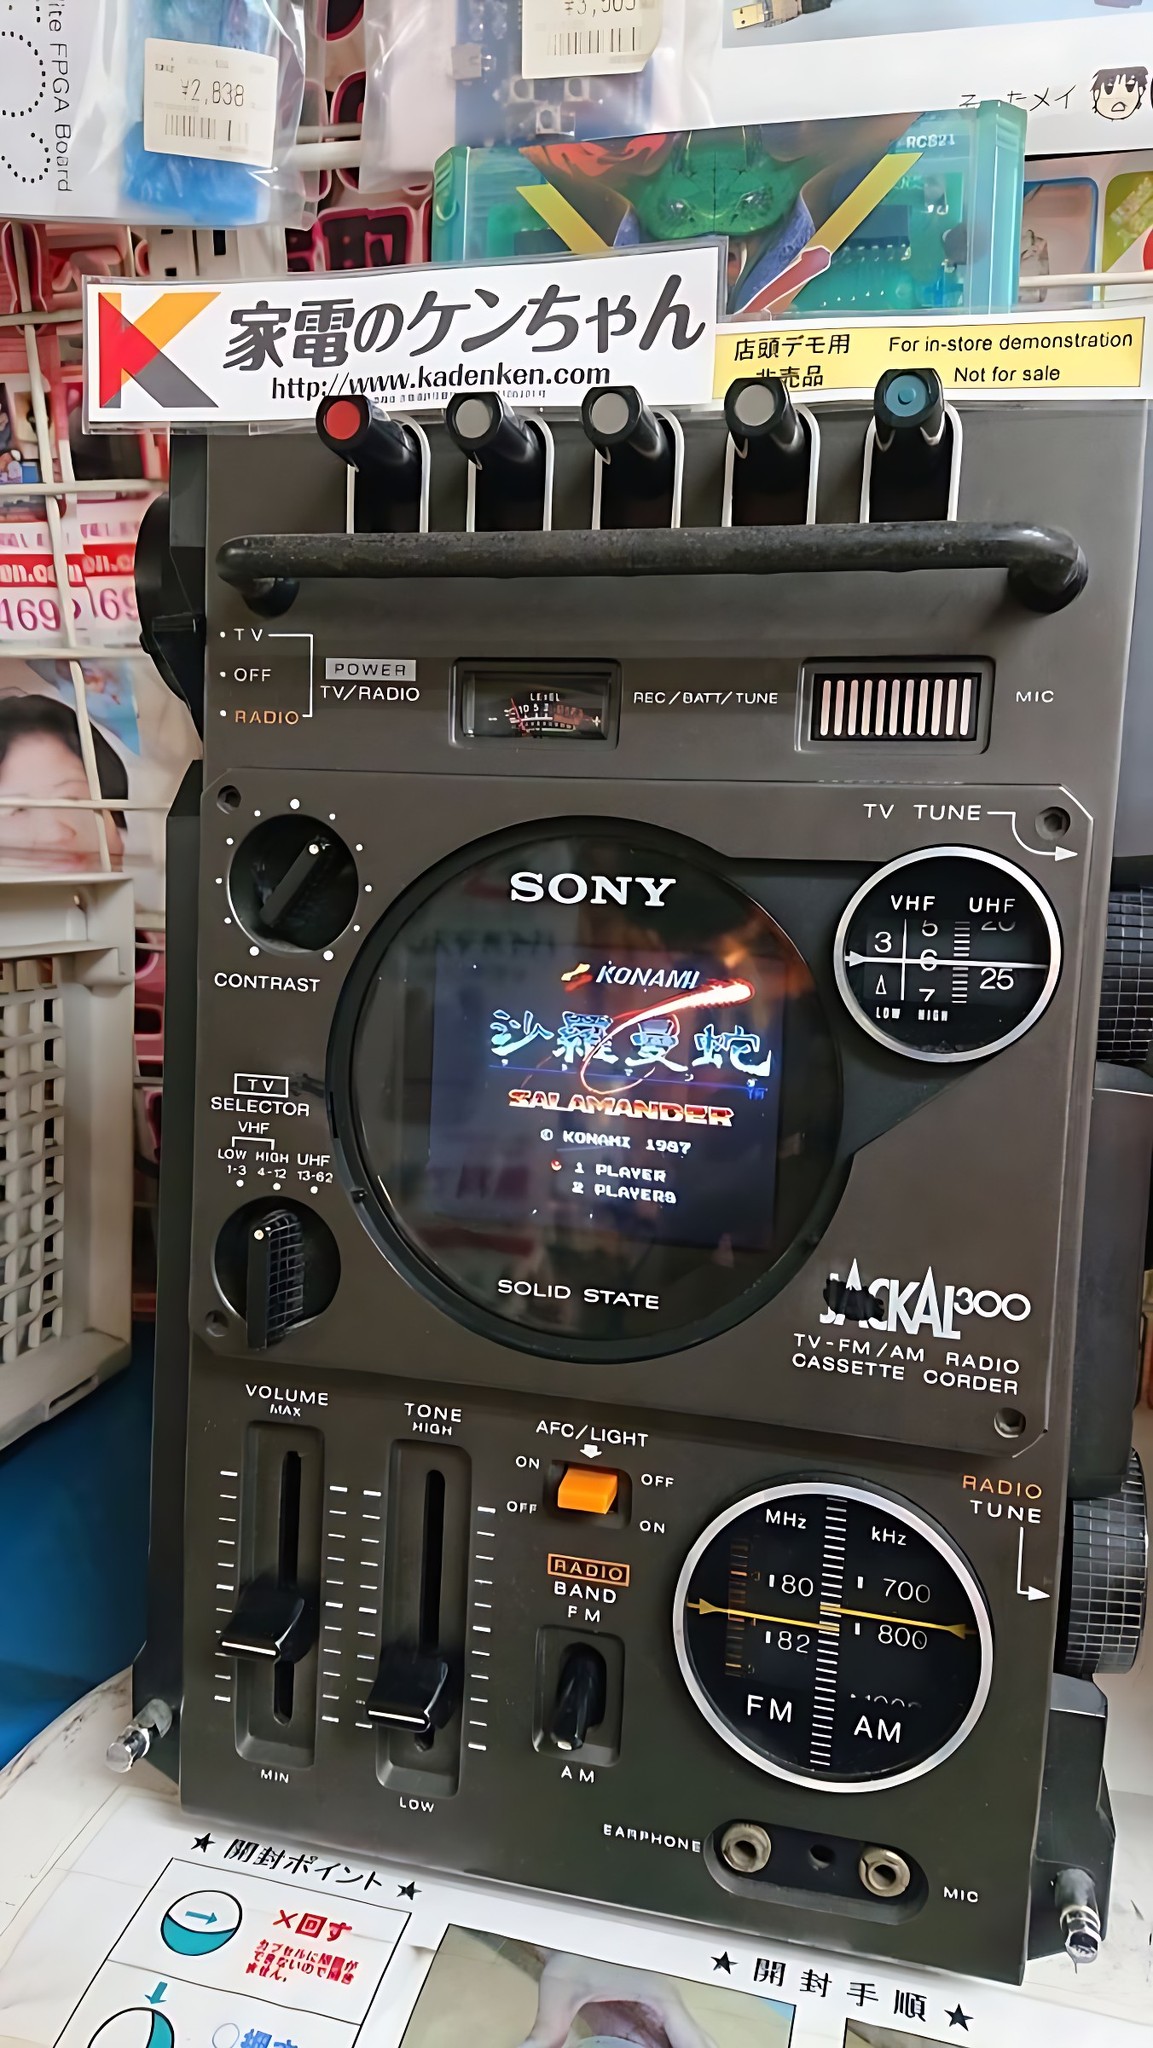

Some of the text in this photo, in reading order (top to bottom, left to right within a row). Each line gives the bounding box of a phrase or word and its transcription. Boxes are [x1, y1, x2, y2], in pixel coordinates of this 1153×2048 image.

[50, 43, 70, 113] FPGA
[181, 78, 245, 107] ¥2,838
[55, 124, 73, 192] Board
[223, 274, 706, 371] 家電のケンちゃん
[734, 333, 851, 362] 店頭デモ用
[889, 332, 1133, 352] For in-store demonstration
[271, 363, 612, 401] http://www.kadenken.com
[954, 366, 1061, 382] Not for sale
[233, 628, 264, 642] TV
[233, 667, 272, 682] OFF
[334, 662, 407, 677] POWER
[320, 684, 420, 702] TV/RADIO
[633, 690, 779, 706] REC/BATT/TUNE
[1015, 689, 1055, 704] MIC
[234, 709, 300, 725] RADIO
[863, 803, 982, 822] TV TUNE
[510, 871, 676, 908] SONY
[890, 894, 1016, 914] VHF UHF
[874, 931, 893, 953] 3
[920, 949, 938, 972] 6
[213, 972, 321, 994] CONTRAST
[595, 964, 700, 989] KONAMI
[979, 967, 1015, 991] 25
[918, 988, 936, 1002] 7
[875, 1006, 949, 1022] LOW HIGH
[489, 1008, 773, 1077] 沙羅曼蛇
[247, 1078, 274, 1092] TV
[210, 1096, 310, 1117] SELECTOR
[508, 1088, 735, 1127] SALAMANDER
[238, 1120, 270, 1135] VHF
[562, 1130, 631, 1149] KONAMI
[645, 1138, 692, 1155] 1987
[217, 1148, 331, 1167] LOW HIGH UHF
[227, 1164, 334, 1184] 1-3 4-12 13-62
[574, 1161, 667, 1183] 1 PLAYER
[571, 1181, 677, 1204] 2 PLAYERS
[497, 1279, 660, 1310] SOLID STATE
[792, 1352, 1019, 1396] CASSETTE CORDER
[945, 1351, 1021, 1375] RADIO
[245, 1383, 330, 1407] VOLUME
[269, 1404, 302, 1418] MAX
[403, 1402, 463, 1423] TONE
[411, 1421, 453, 1436] HIGH
[535, 1418, 649, 1448] AFC/LIGHT
[515, 1455, 541, 1470] ON
[640, 1472, 675, 1489] OFF
[961, 1474, 1043, 1500] RADIO
[506, 1500, 538, 1515] OFF
[969, 1499, 1041, 1525] TUNE
[639, 1519, 666, 1535] ON
[765, 1508, 907, 1547] MHz kHz
[553, 1558, 625, 1582] RADIO
[554, 1581, 618, 1605] BAND
[781, 1573, 931, 1604] 80 700
[567, 1605, 601, 1623] FM
[777, 1623, 928, 1654] 82 800
[746, 1693, 902, 1744] FM AM
[260, 1768, 289, 1784] MIN
[560, 1765, 595, 1783] AM
[399, 1796, 435, 1813] LOW
[603, 1823, 702, 1854] EARPHONE
[224, 1838, 383, 1891] 開封ポイント
[943, 1886, 980, 1903] MIC
[753, 1957, 928, 2022] 開封手順
